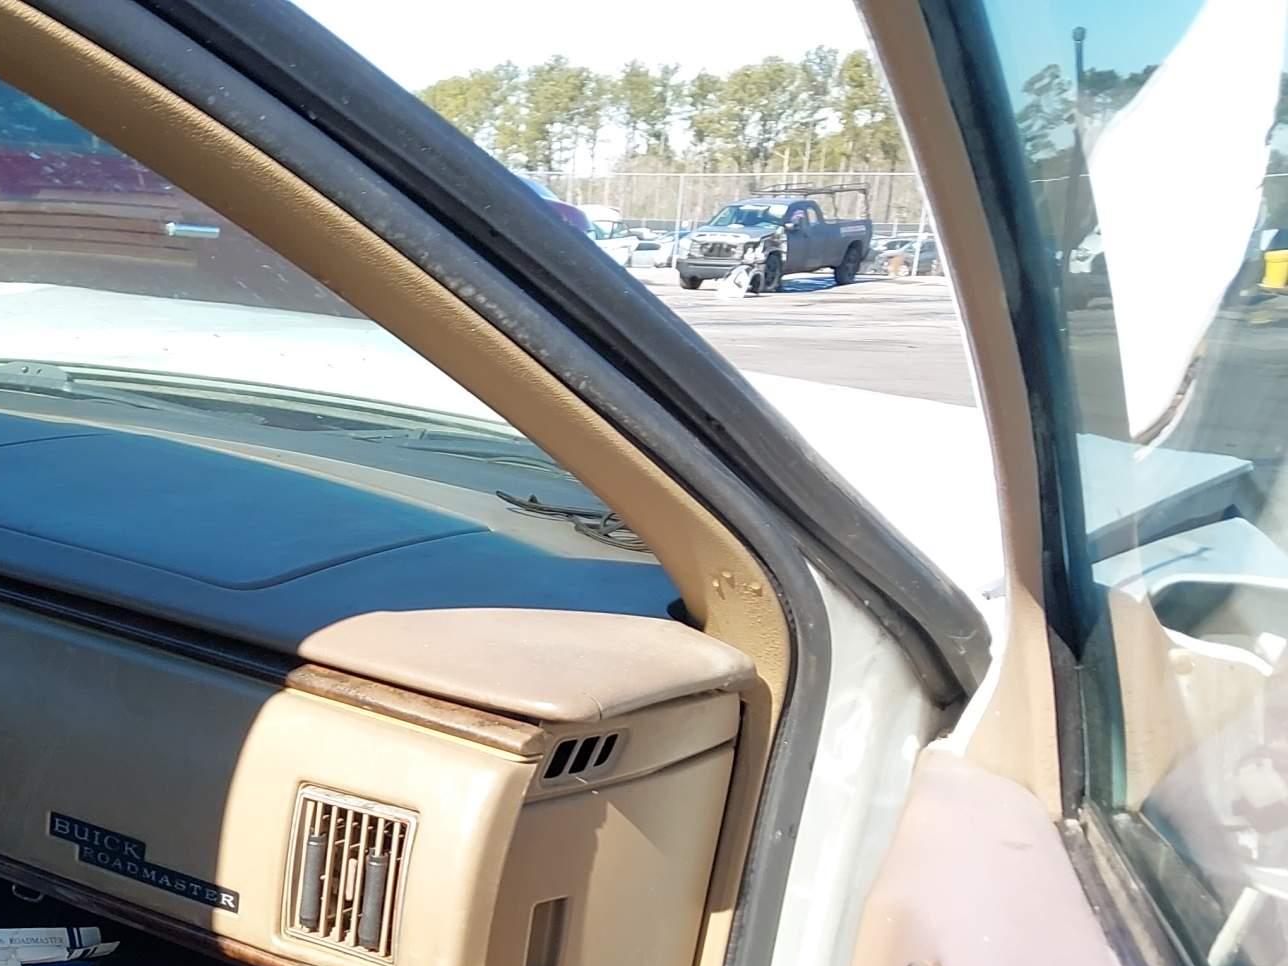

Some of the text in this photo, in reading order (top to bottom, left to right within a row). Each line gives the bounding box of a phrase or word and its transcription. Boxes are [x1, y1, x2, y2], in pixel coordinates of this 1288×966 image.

[53, 817, 142, 860] BUICK
[82, 846, 236, 908] ROADMASTER
[8, 936, 64, 945] ROADMASTER
